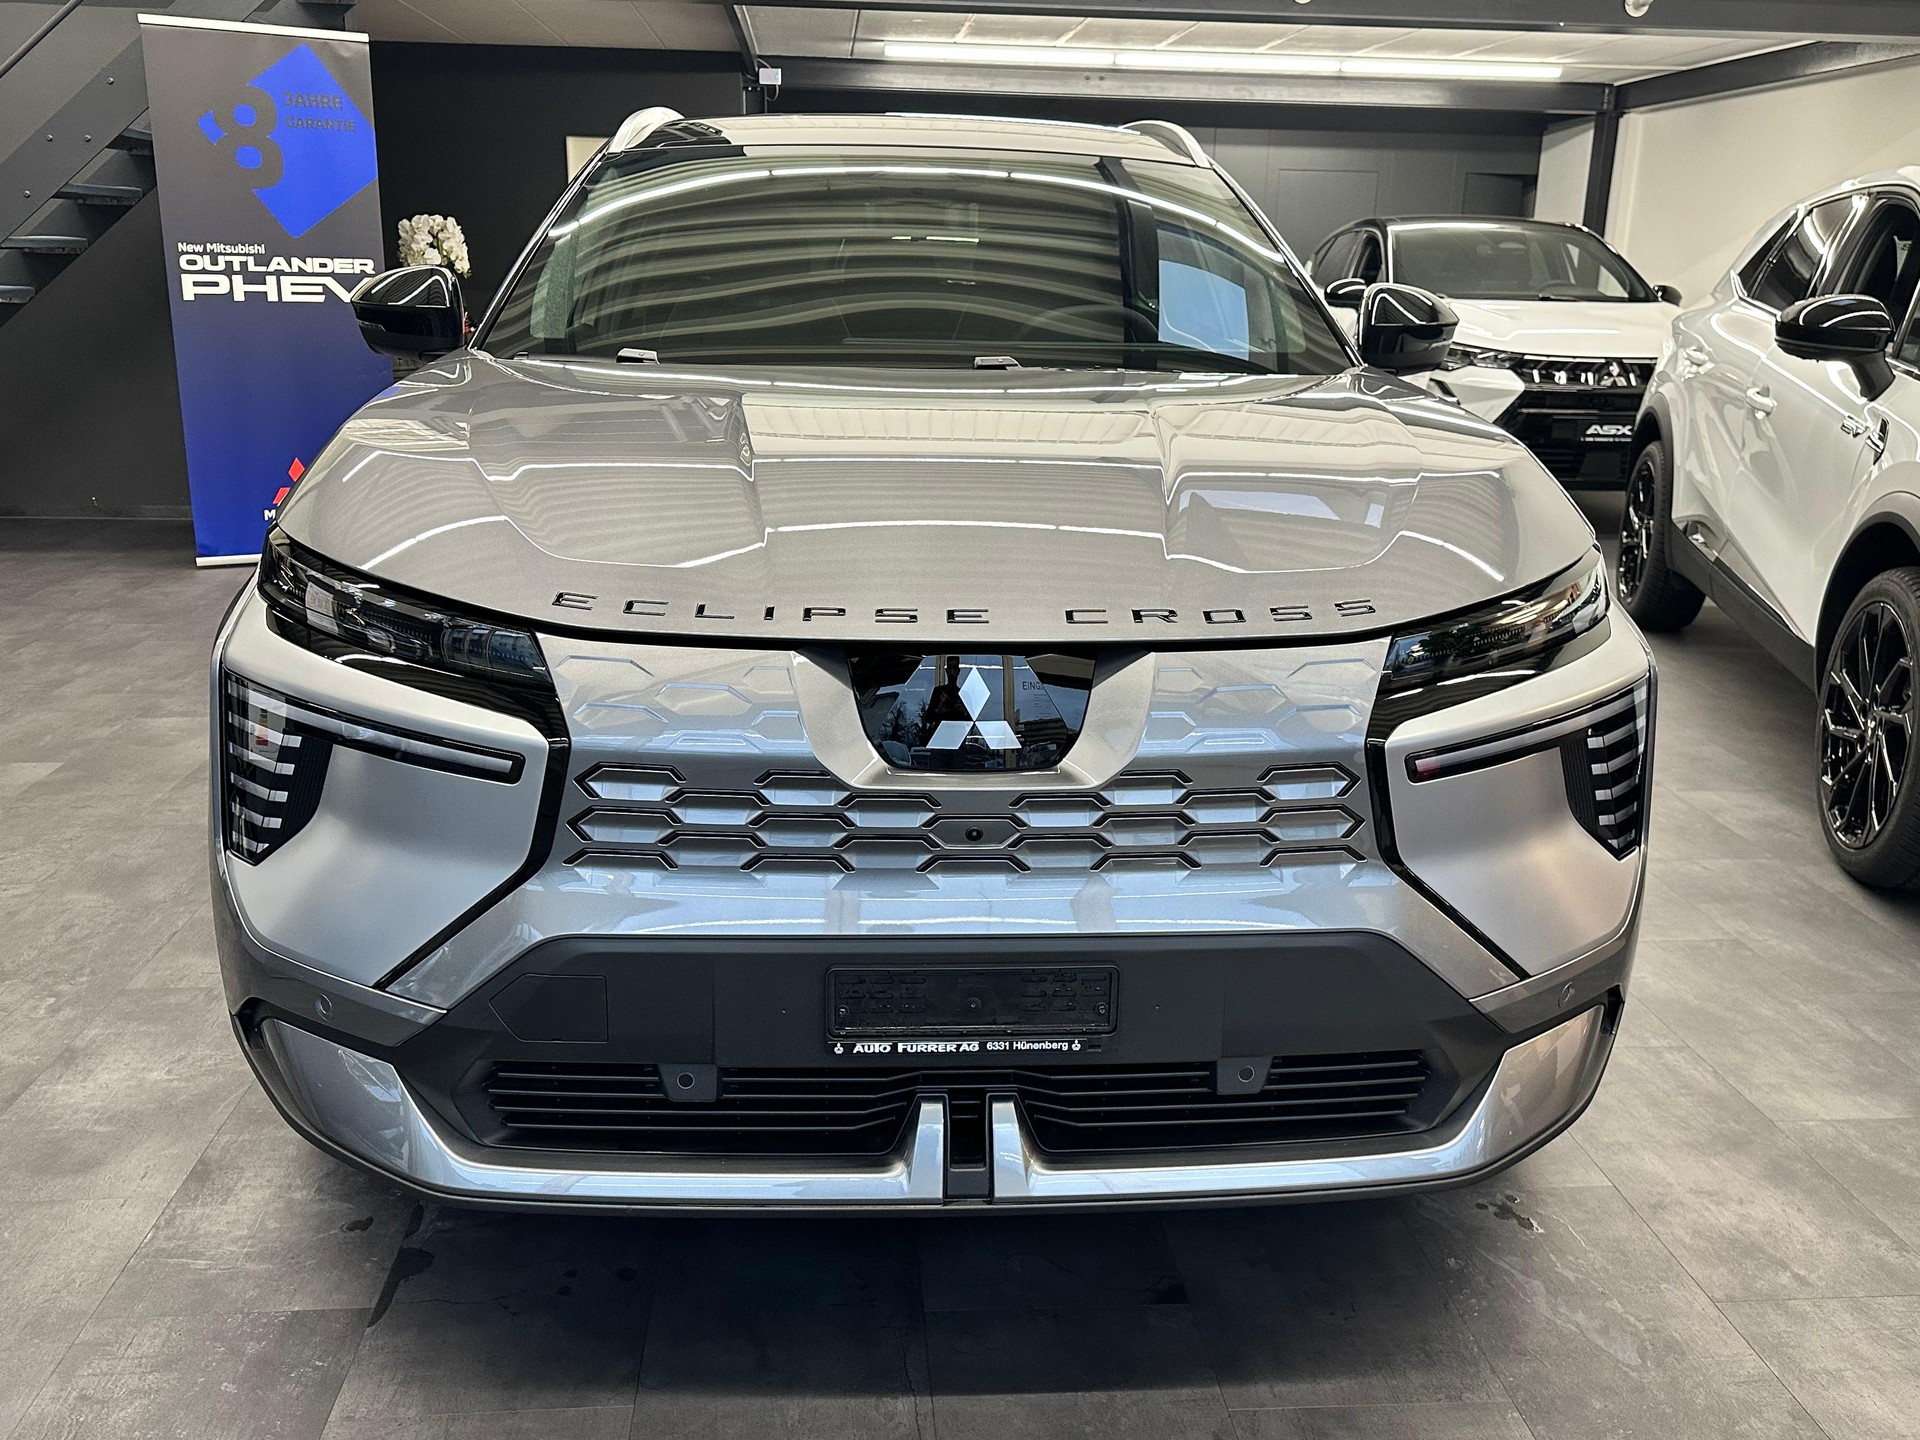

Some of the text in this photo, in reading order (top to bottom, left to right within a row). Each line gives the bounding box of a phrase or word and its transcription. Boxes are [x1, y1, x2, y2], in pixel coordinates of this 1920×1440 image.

[283, 92, 343, 110] JAHRE
[285, 116, 356, 132] GARANTIE
[213, 86, 284, 190] 8
[178, 242, 266, 254] New Mitsubishi
[179, 254, 376, 274] OUTLANDER
[180, 273, 372, 303] PHEV
[1585, 424, 1633, 436] ASX
[551, 590, 1377, 625] ECLIPSE CROSS
[898, 1041, 957, 1053] FURRER
[959, 1041, 980, 1052] AG
[986, 1041, 1010, 1051] 6331
[1013, 1040, 1069, 1051] Hünenberg
